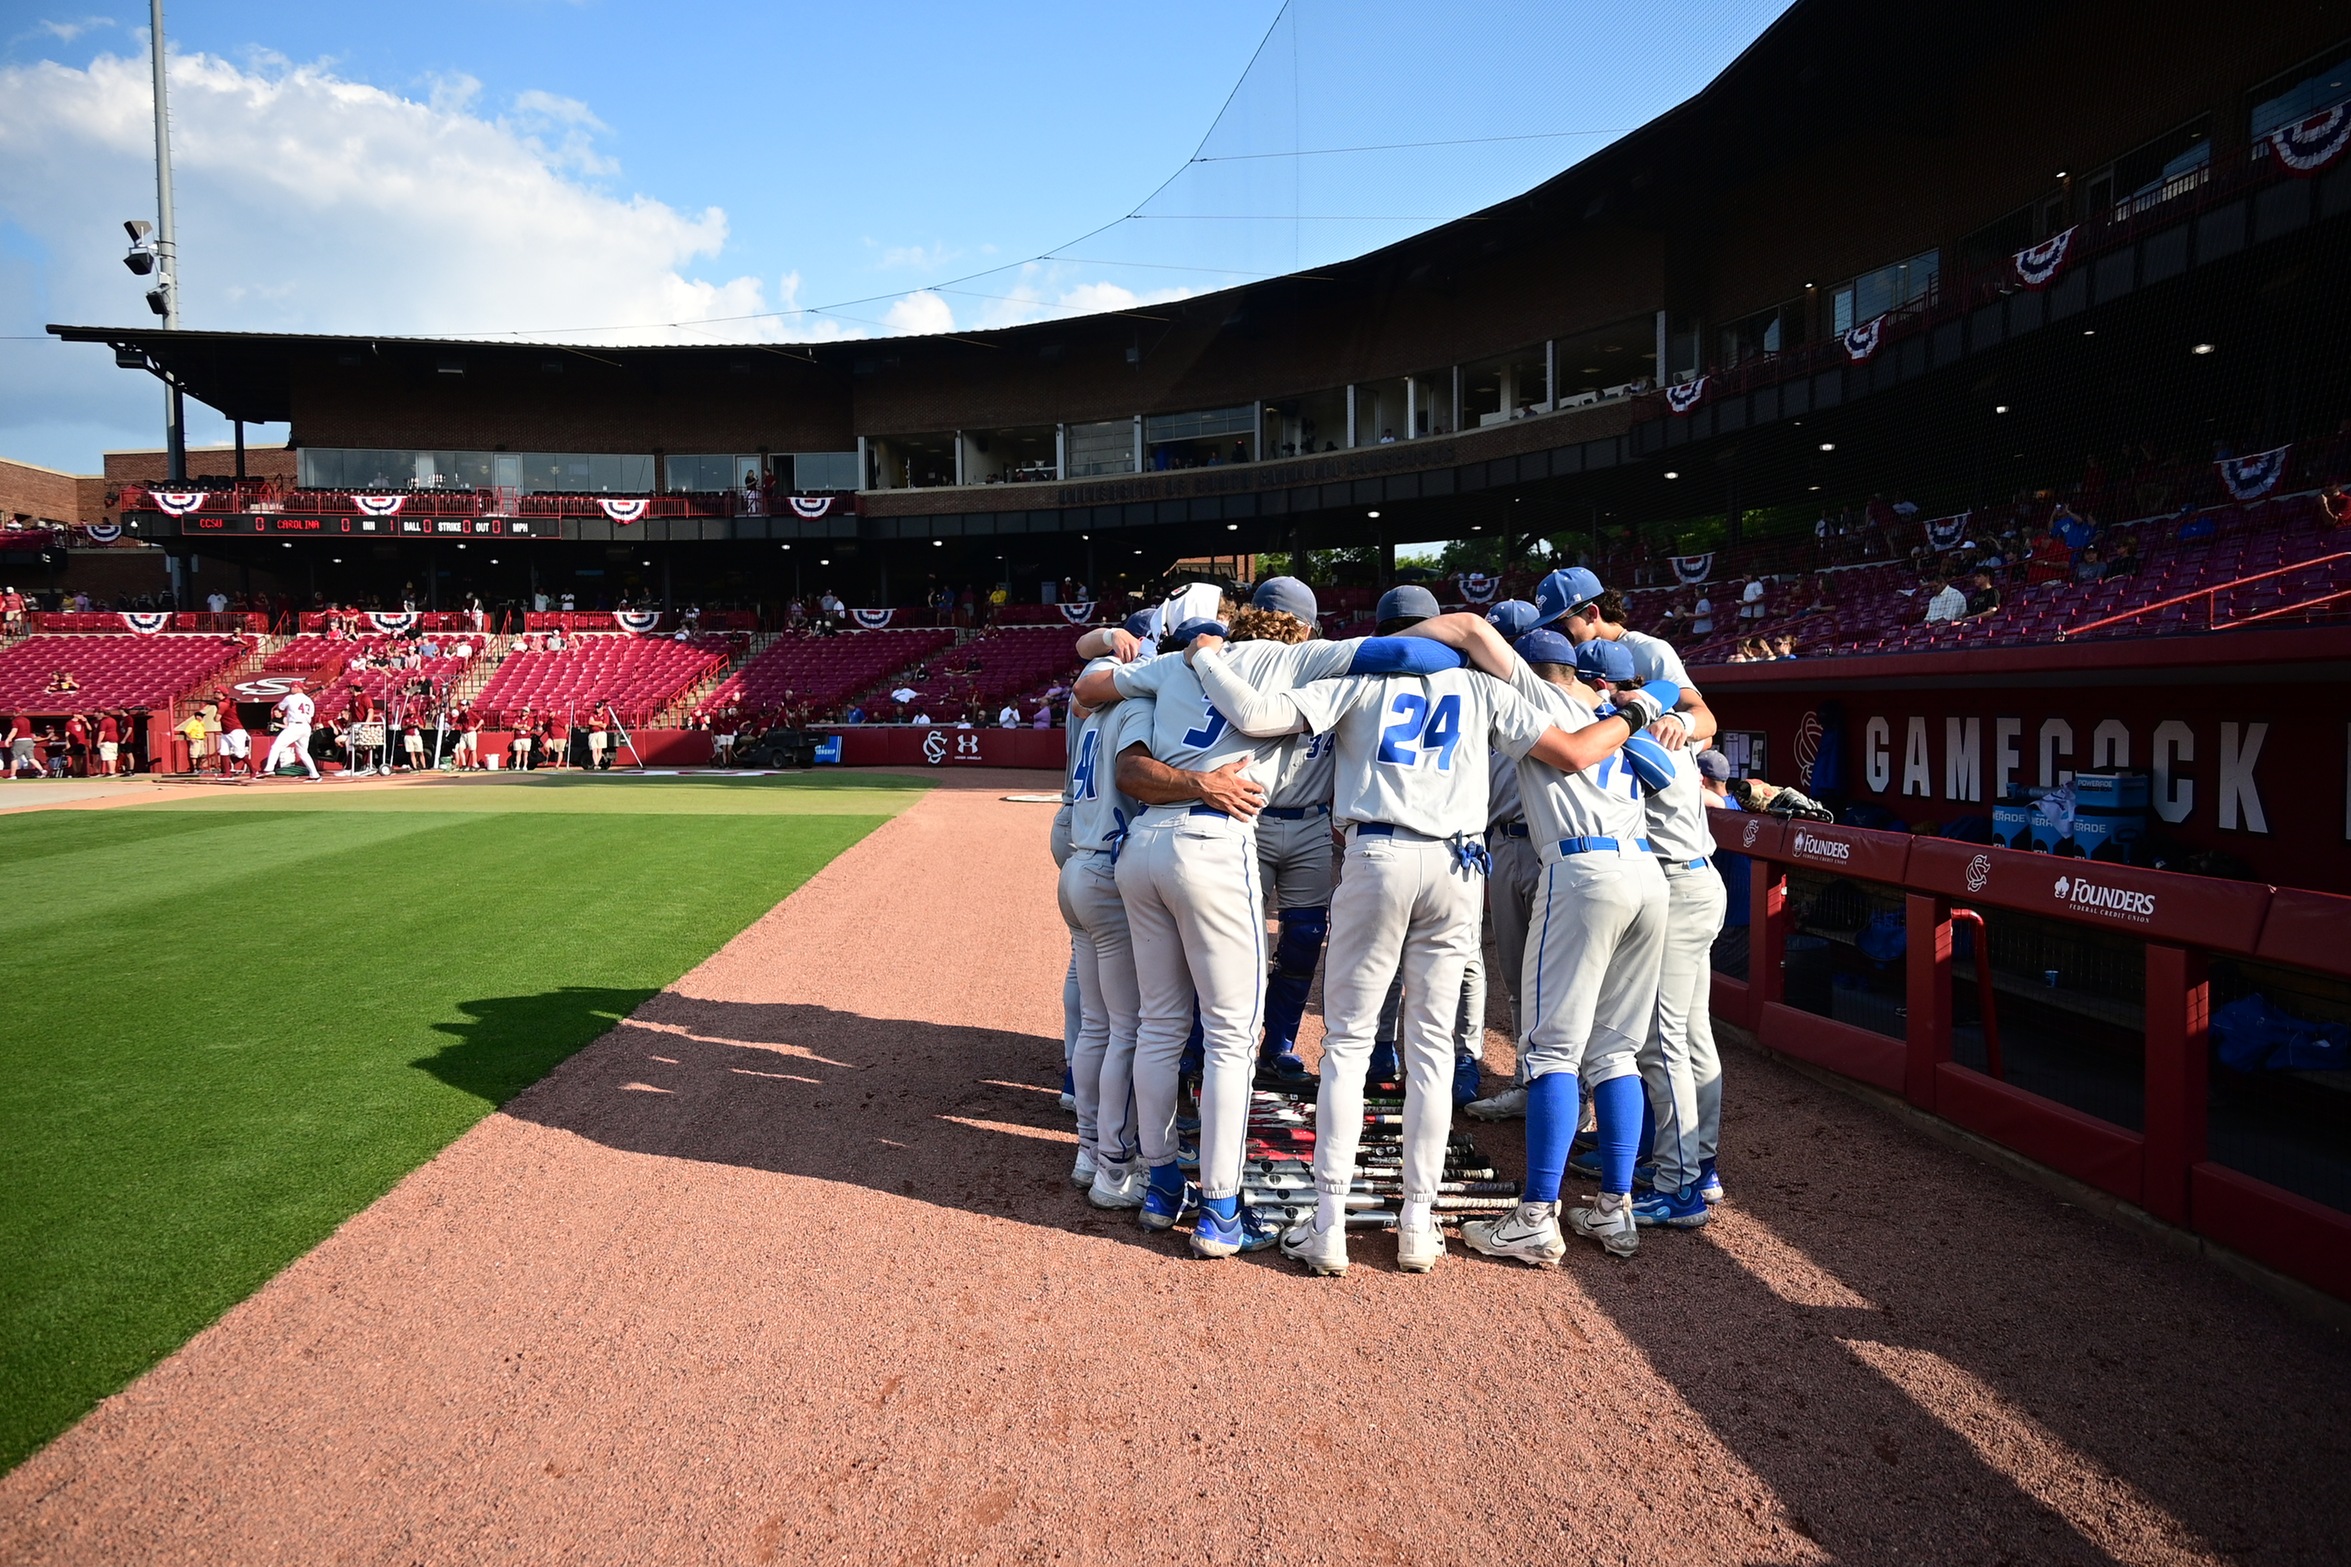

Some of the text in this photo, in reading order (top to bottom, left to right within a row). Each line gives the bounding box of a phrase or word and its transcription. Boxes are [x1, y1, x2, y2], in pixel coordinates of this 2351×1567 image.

[199, 518, 223, 529] CCSU
[276, 519, 320, 530] CAROLINA
[403, 521, 421, 532] BALL
[438, 521, 462, 533] STRIKE
[475, 522, 490, 533] OUT
[512, 522, 529, 533] MPH
[1376, 692, 1462, 772] 24
[1305, 732, 1336, 760] 34
[2077, 779, 2113, 788] POWERADE
[1803, 834, 1850, 859] FOUNDERS
[2070, 878, 2156, 915] FOUNDERS
[2069, 903, 2151, 924] FEDERAL CREDIT UNION
